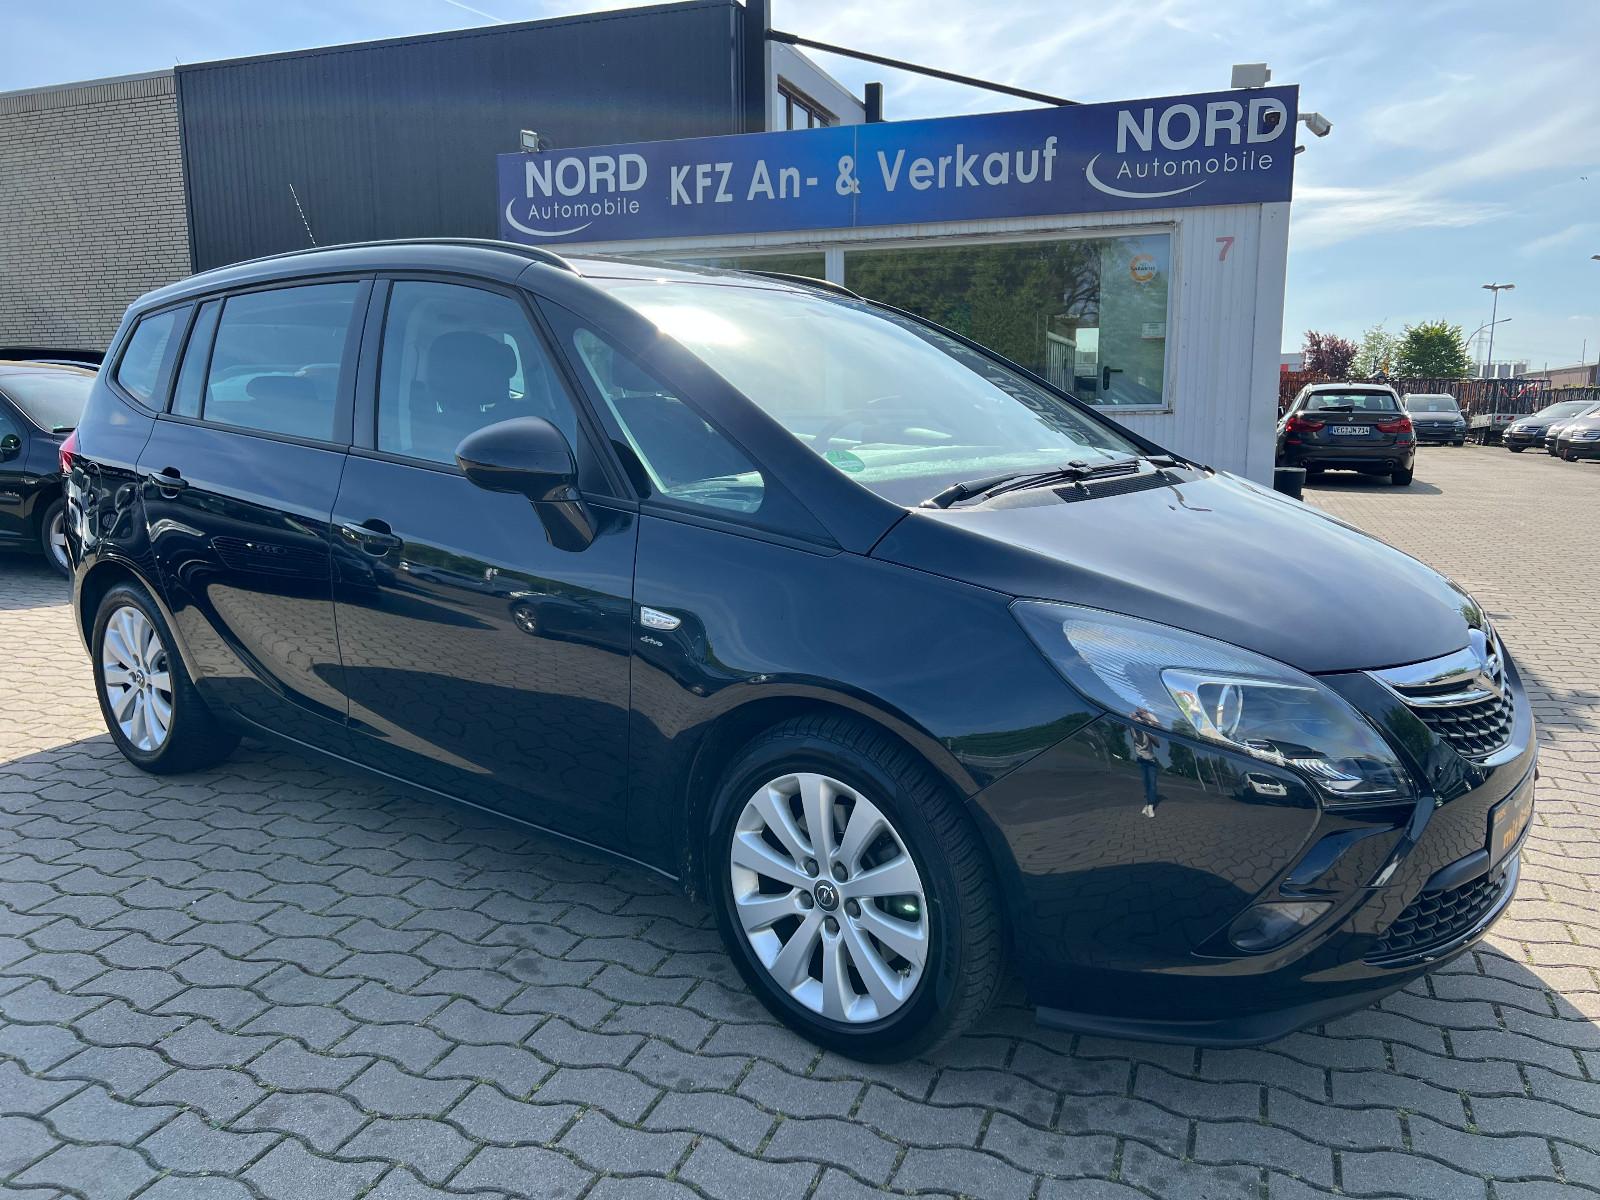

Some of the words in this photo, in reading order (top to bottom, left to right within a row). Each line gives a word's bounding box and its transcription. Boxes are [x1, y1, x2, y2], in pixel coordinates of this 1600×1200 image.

[1116, 97, 1288, 153] NORD
[524, 153, 648, 198] NORD
[670, 161, 734, 206] KFZ
[746, 159, 818, 201] An-
[835, 154, 863, 196] &
[876, 135, 1059, 192] Verkauf
[1116, 150, 1274, 180] Automobile
[528, 197, 641, 221] Automobile
[1215, 236, 1235, 262] 7
